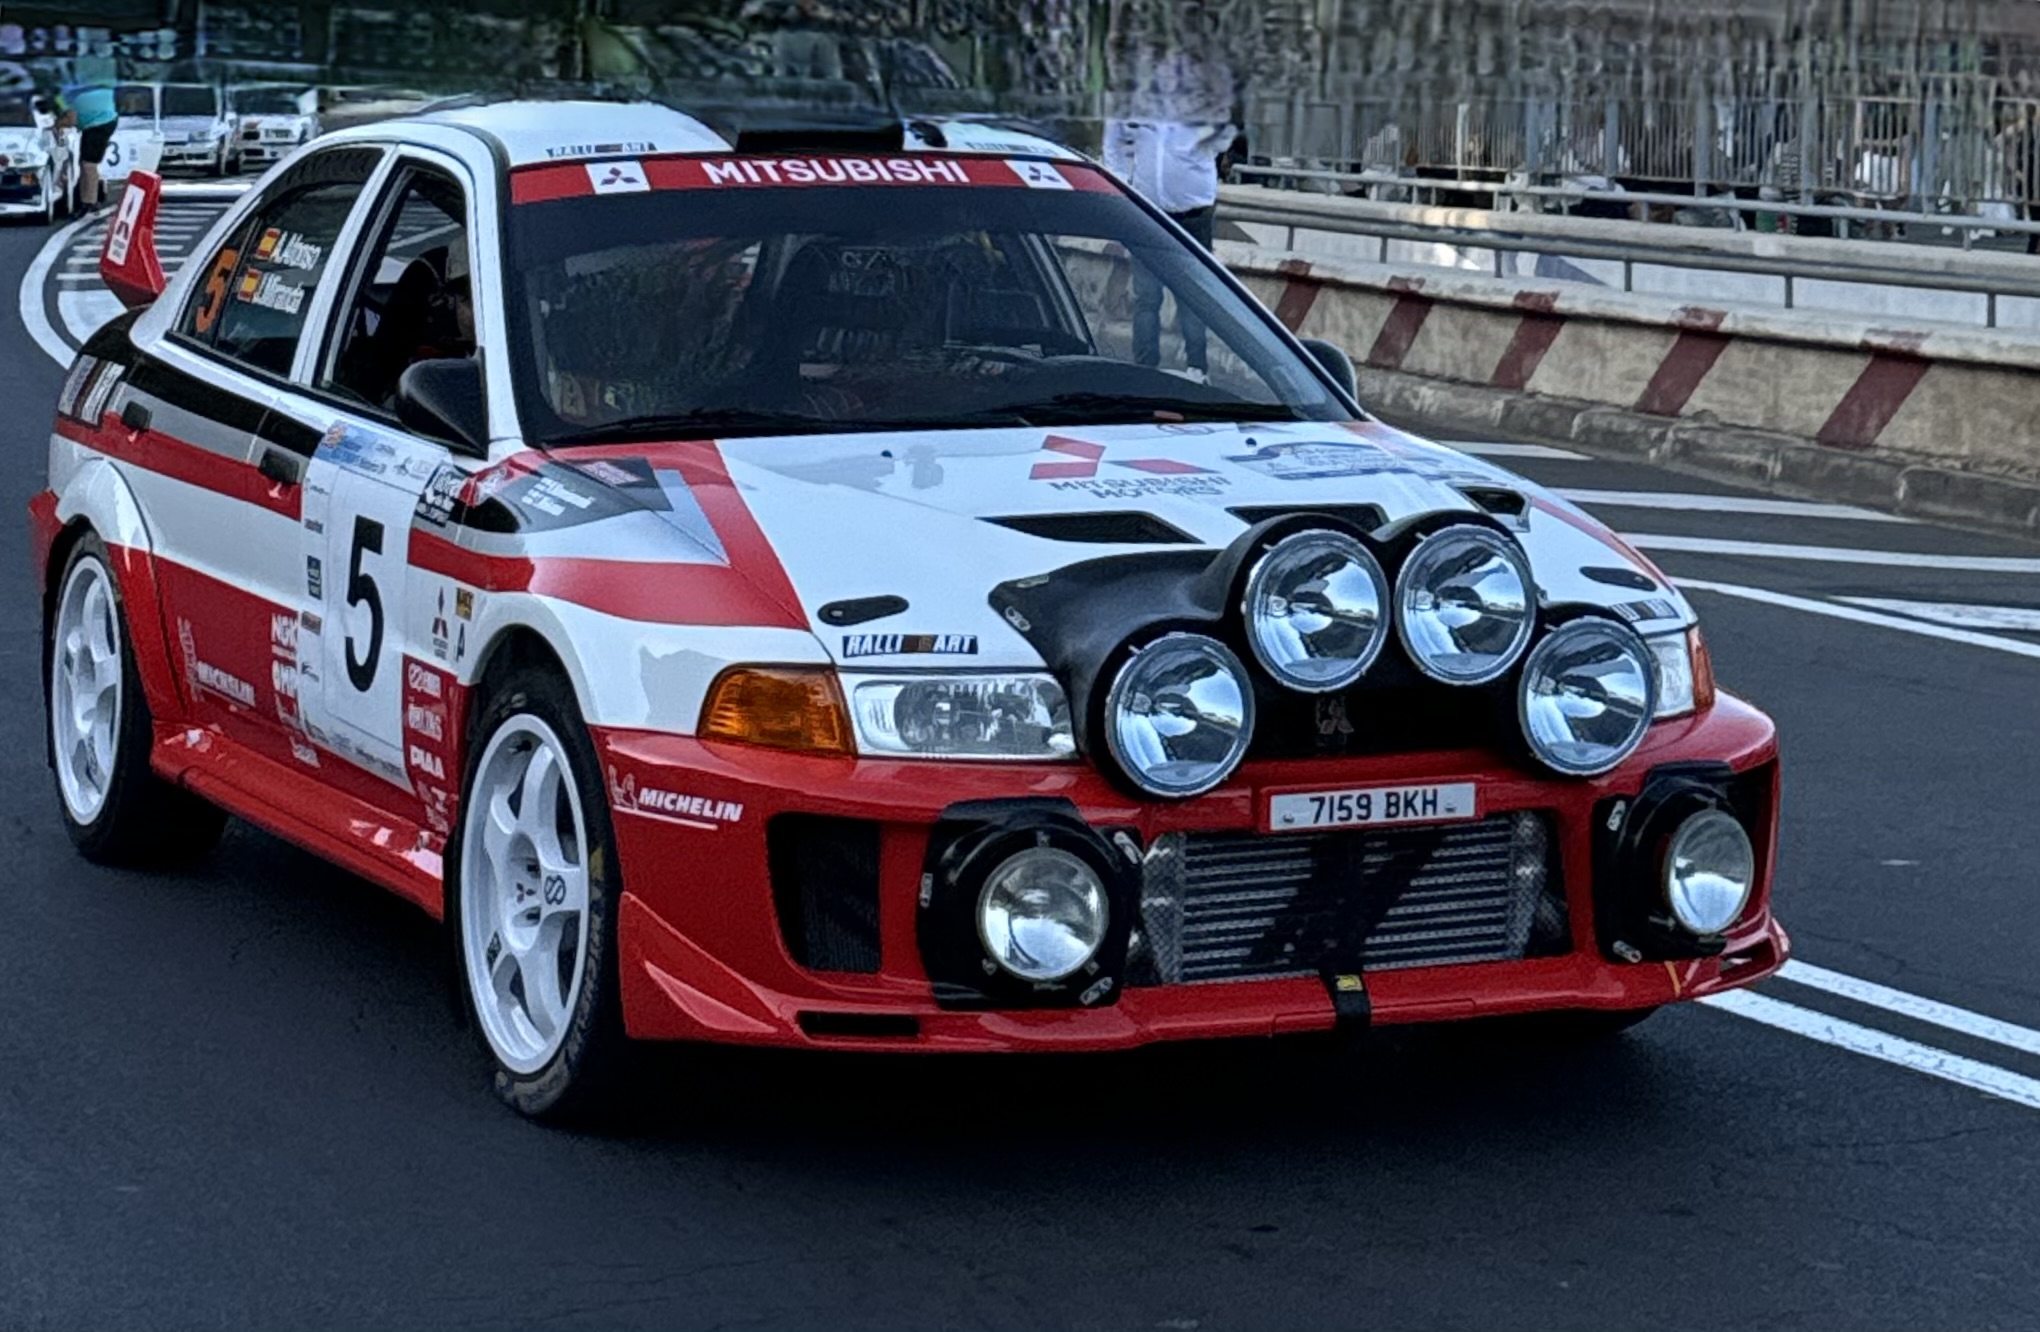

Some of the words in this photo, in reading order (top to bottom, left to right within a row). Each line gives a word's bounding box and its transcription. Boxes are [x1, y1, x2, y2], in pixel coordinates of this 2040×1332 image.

[106, 141, 121, 167] 3
[701, 158, 971, 186] MITSUBISHI
[344, 514, 384, 692] 5
[639, 787, 744, 822] MICHELIN
[1309, 793, 1372, 824] 7159
[1385, 788, 1438, 819] BKH
